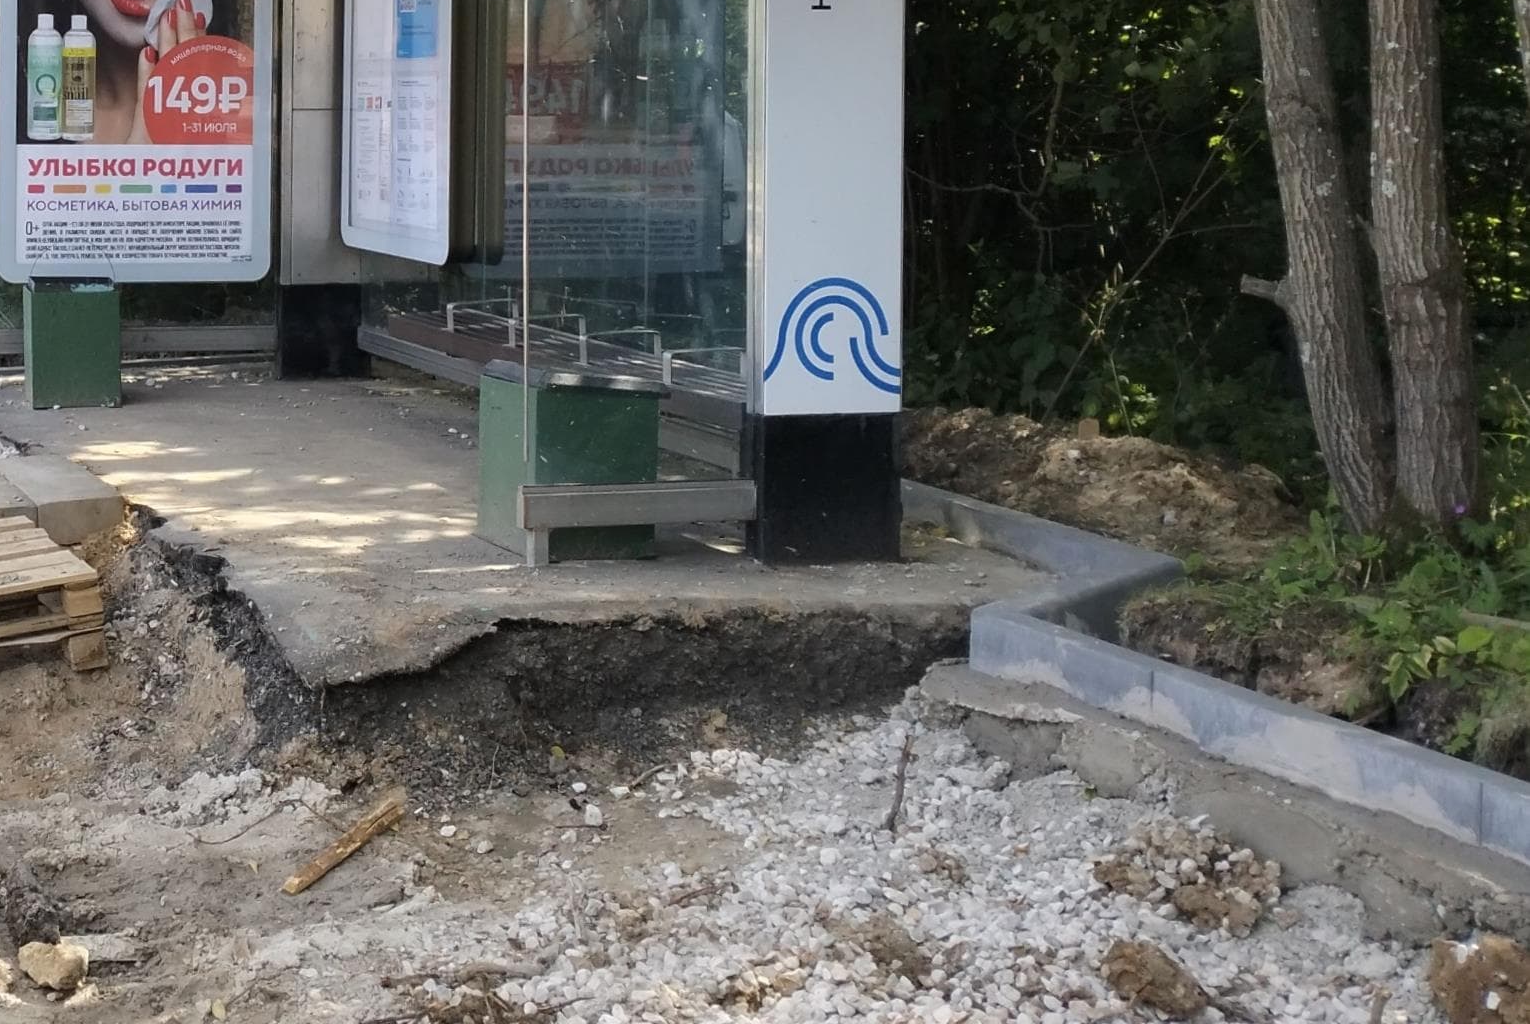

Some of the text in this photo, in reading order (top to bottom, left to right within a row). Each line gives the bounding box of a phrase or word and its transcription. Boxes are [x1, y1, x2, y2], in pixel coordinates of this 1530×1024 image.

[204, 122, 237, 133] ИЮЛЯ
[27, 200, 243, 213] КОСМЕТИКА, БЫТОВАЯ ХИМИЯ
